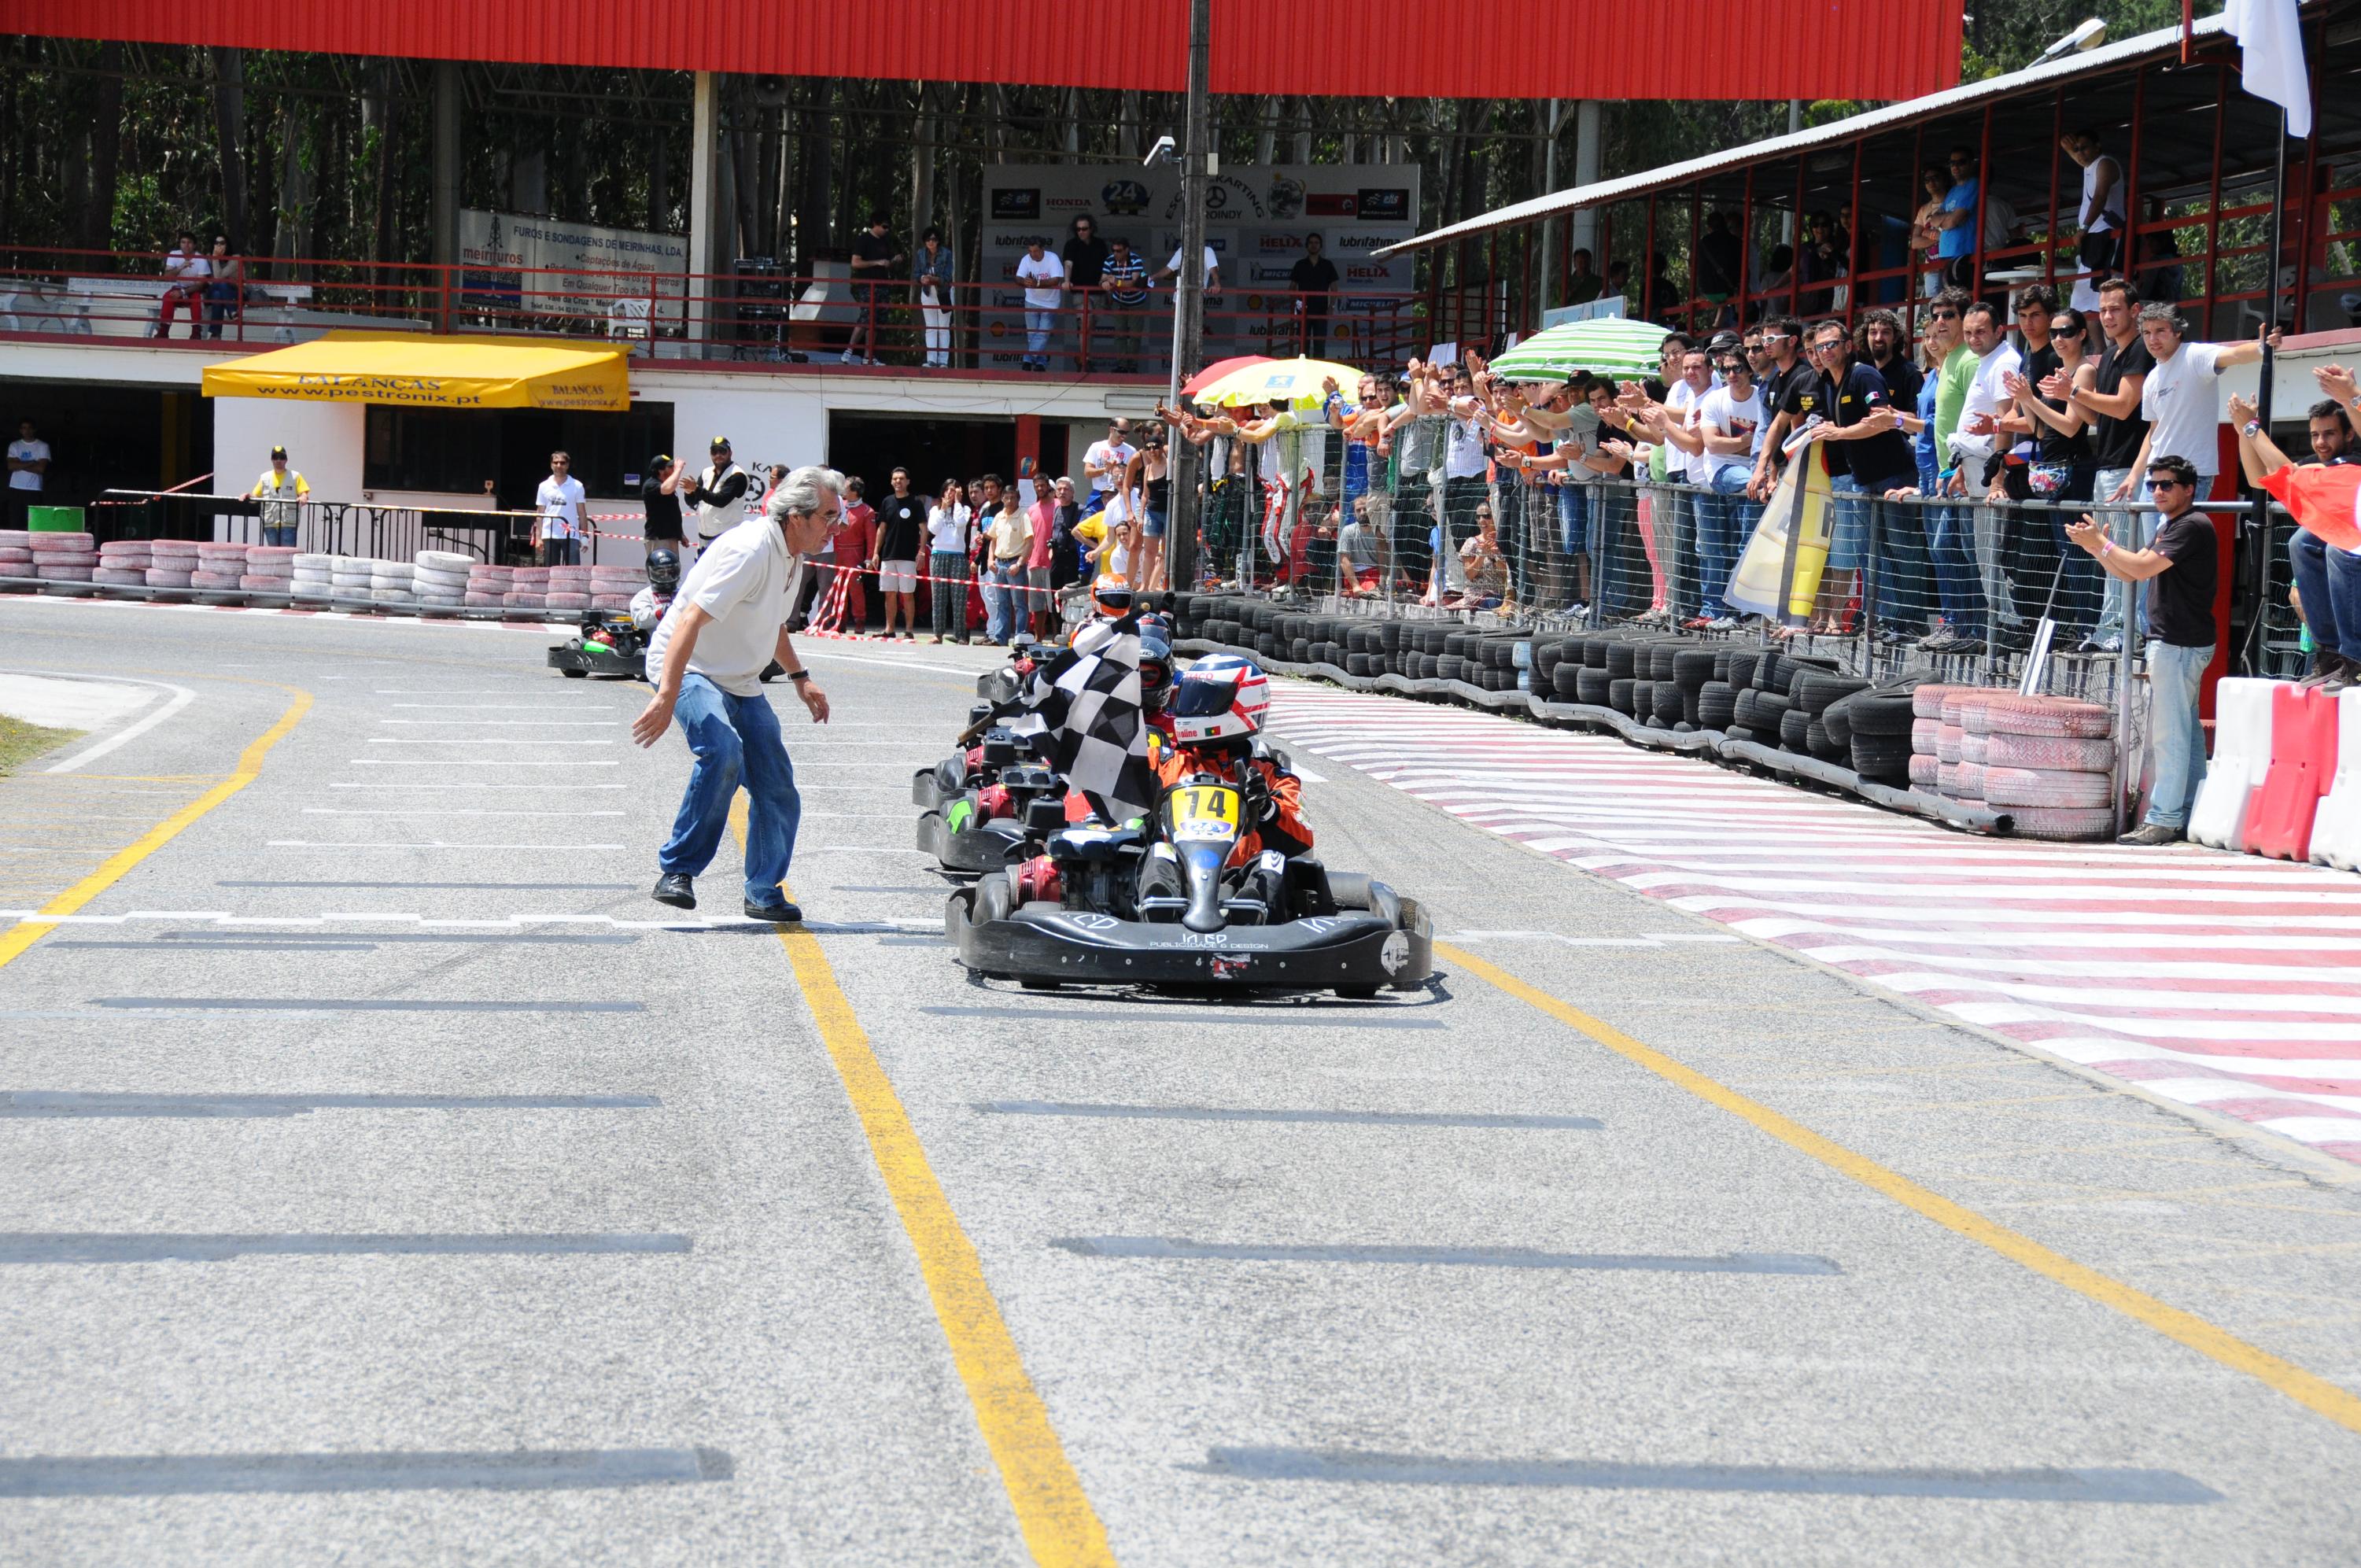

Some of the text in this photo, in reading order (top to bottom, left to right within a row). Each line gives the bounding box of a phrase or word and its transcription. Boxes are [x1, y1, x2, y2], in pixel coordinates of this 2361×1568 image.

[1216, 174, 1264, 219] KARTING
[513, 226, 542, 240] FUROS
[544, 231, 551, 242] E
[552, 233, 603, 248] SONDAGENS
[606, 238, 618, 249] DE
[619, 241, 664, 256] MEIRINHAS,
[1260, 237, 1304, 247] HELIX
[622, 260, 631, 269] de
[633, 258, 655, 271] Águas
[1347, 267, 1391, 278] HELIX
[562, 278, 575, 289] Em
[577, 279, 611, 293] Qualquer
[299, 374, 441, 391] BALANÇAS
[257, 387, 481, 406] www.pestronix.pt
[552, 385, 605, 397] BALANÇAS
[1185, 789, 1227, 819] 74
